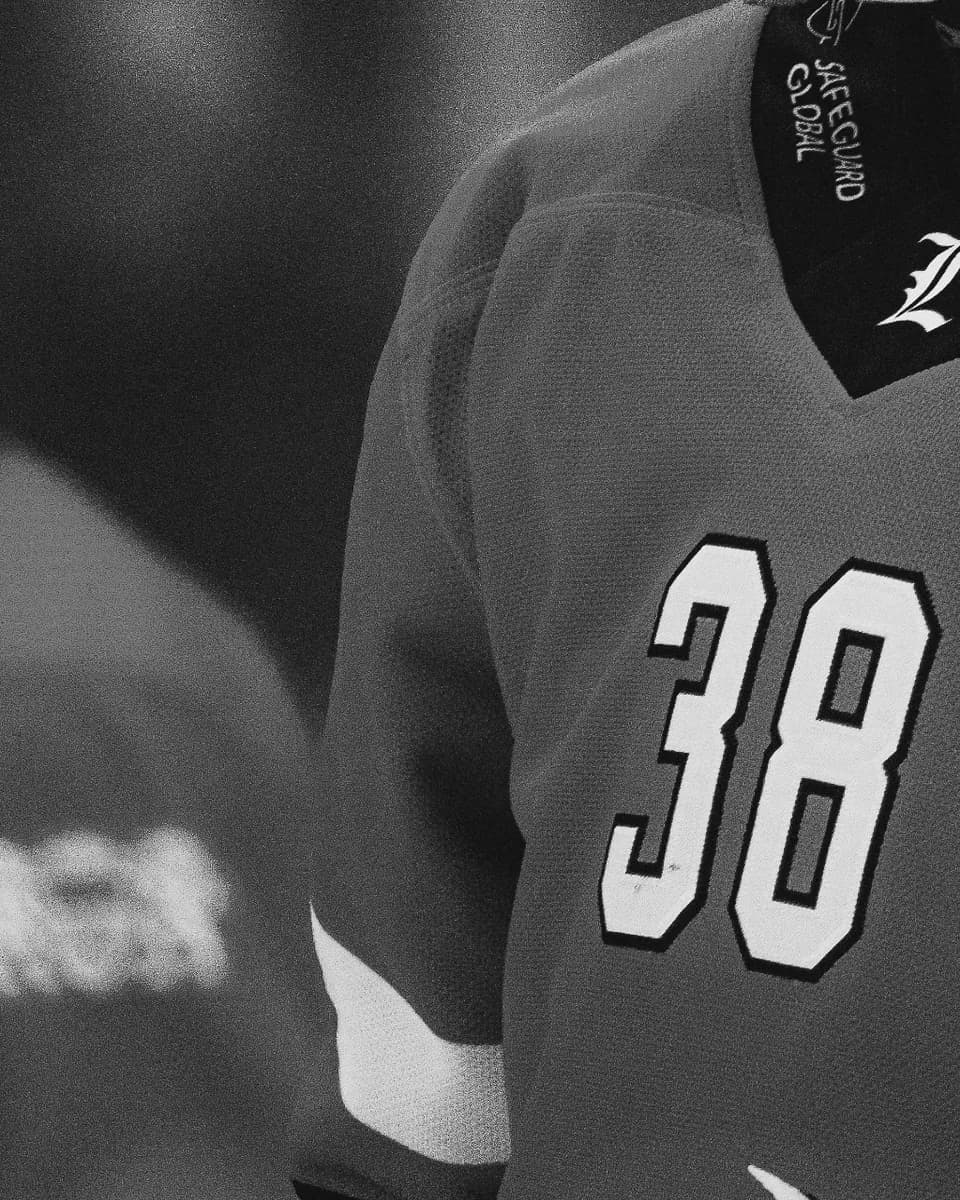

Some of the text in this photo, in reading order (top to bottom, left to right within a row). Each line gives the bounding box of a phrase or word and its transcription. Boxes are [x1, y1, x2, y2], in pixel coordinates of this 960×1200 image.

[786, 62, 826, 163] GLOBAL
[814, 58, 866, 202] SAFEGUARD
[600, 532, 942, 982] 38
